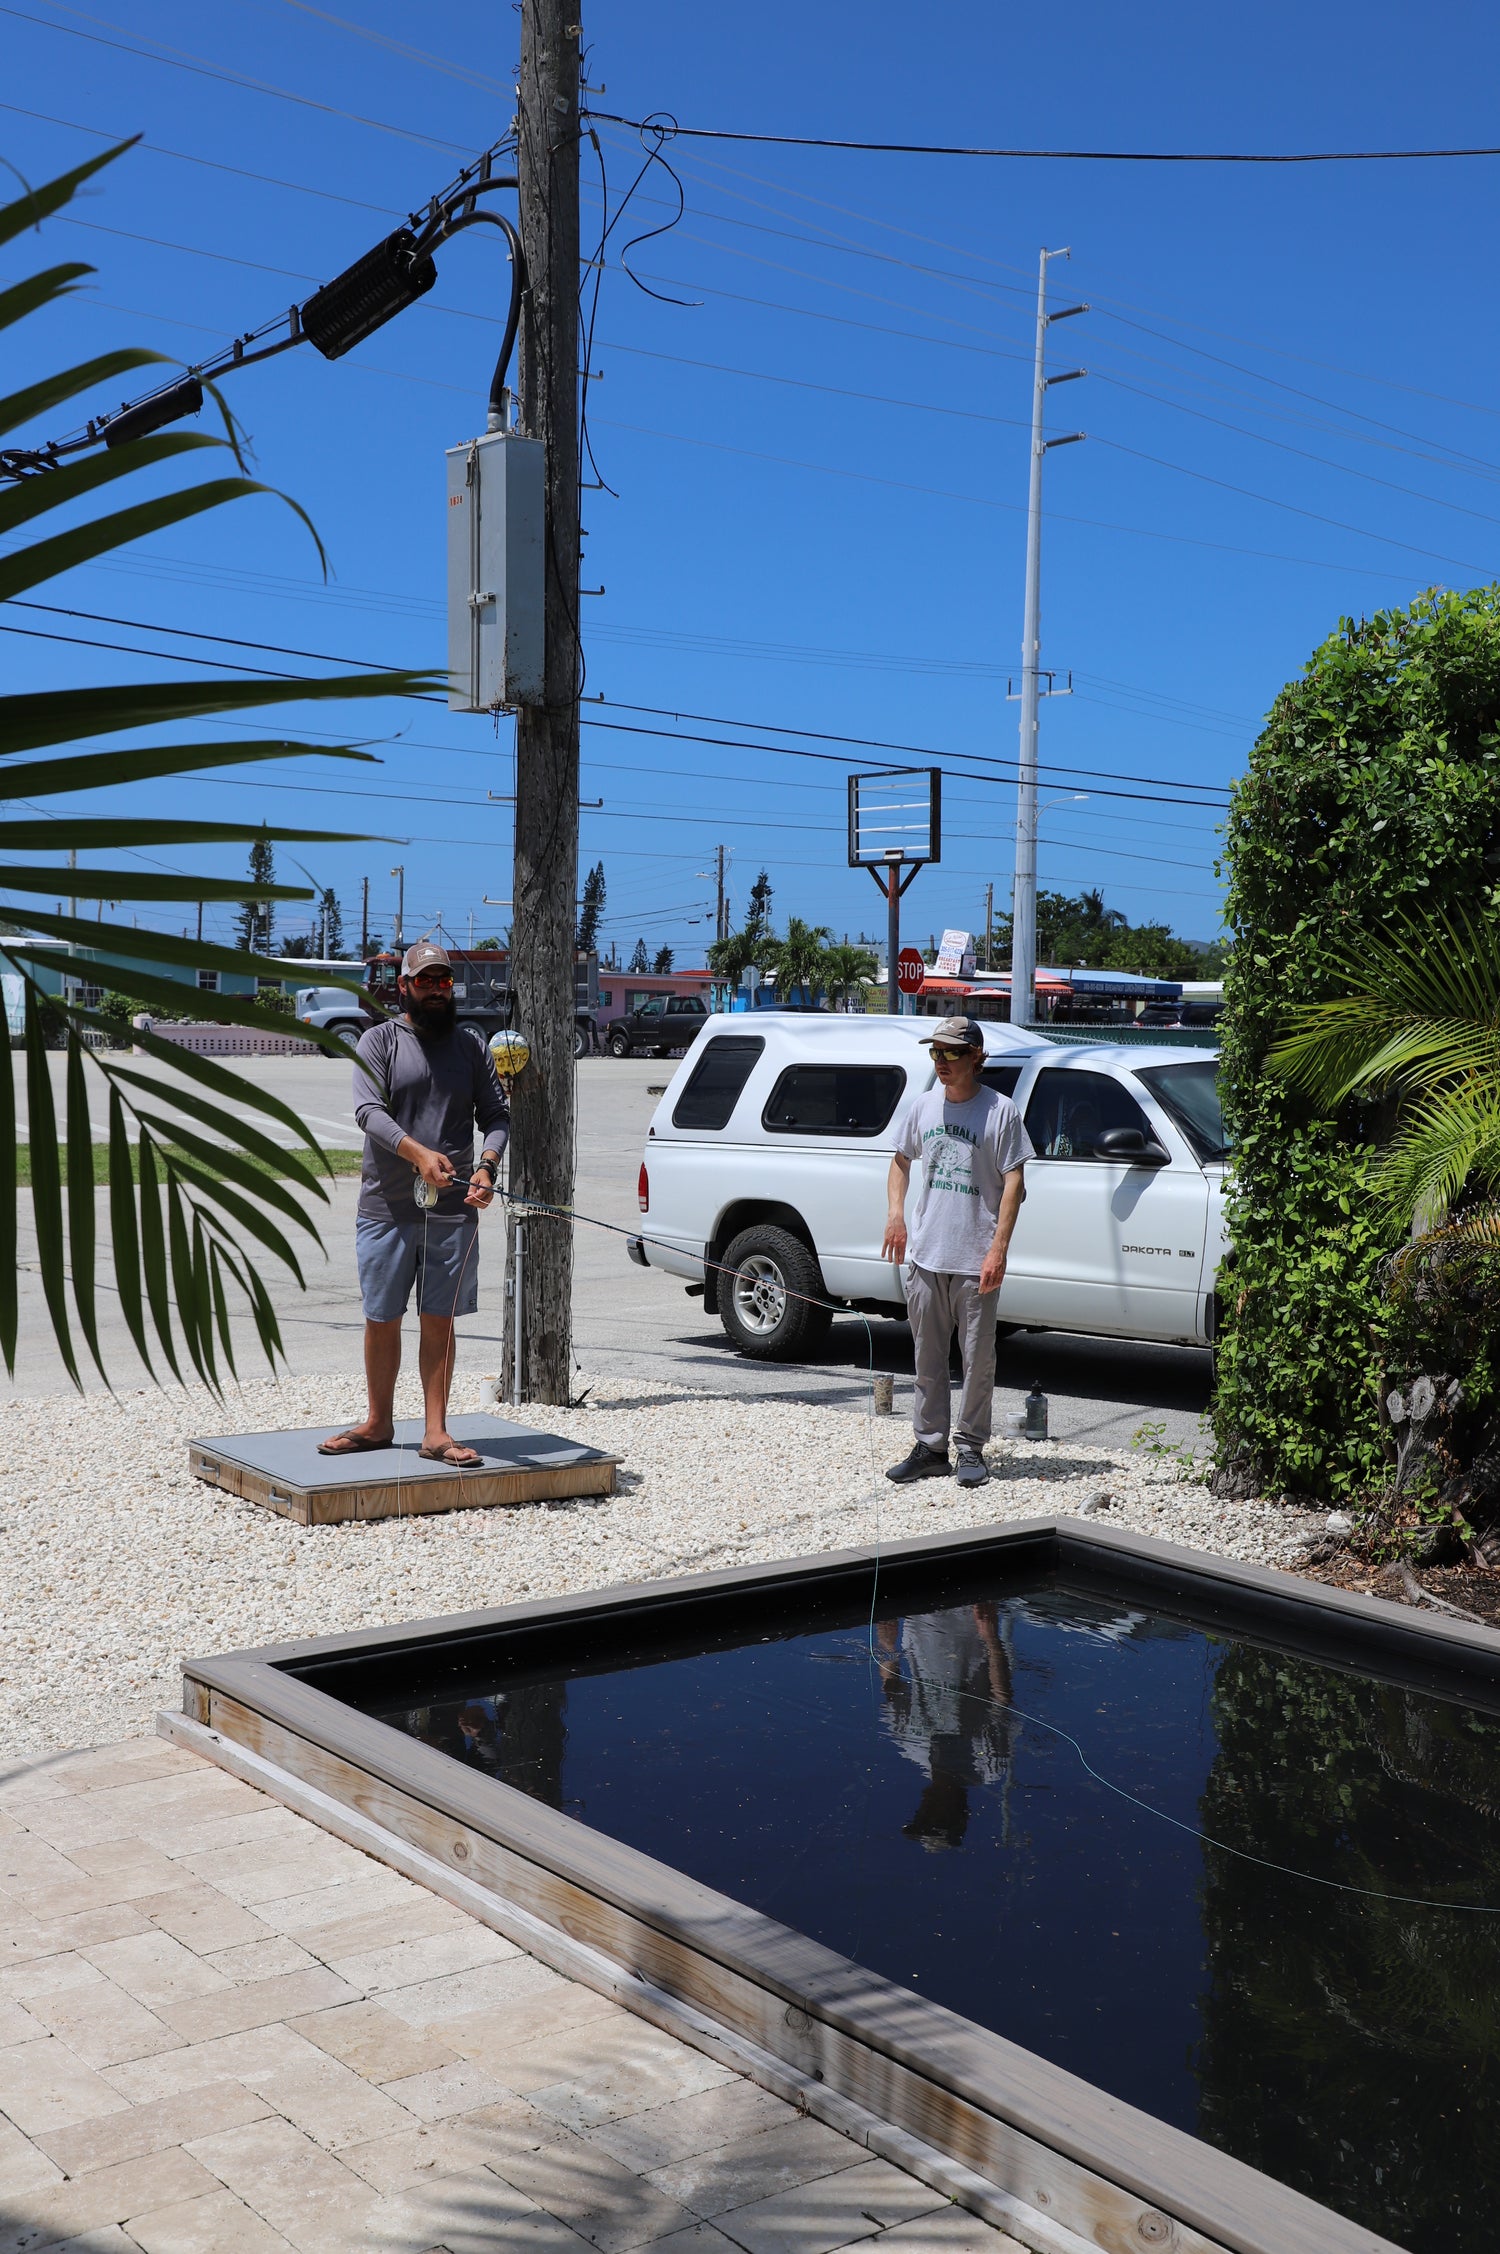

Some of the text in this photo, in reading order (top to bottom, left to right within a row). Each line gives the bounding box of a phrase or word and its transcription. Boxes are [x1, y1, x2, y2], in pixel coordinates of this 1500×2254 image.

[898, 962, 923, 979] STOP
[923, 1124, 978, 1145] BASEBALL
[929, 1179, 980, 1196] CHRISTMAS
[1122, 1245, 1171, 1256] DAKOTA
